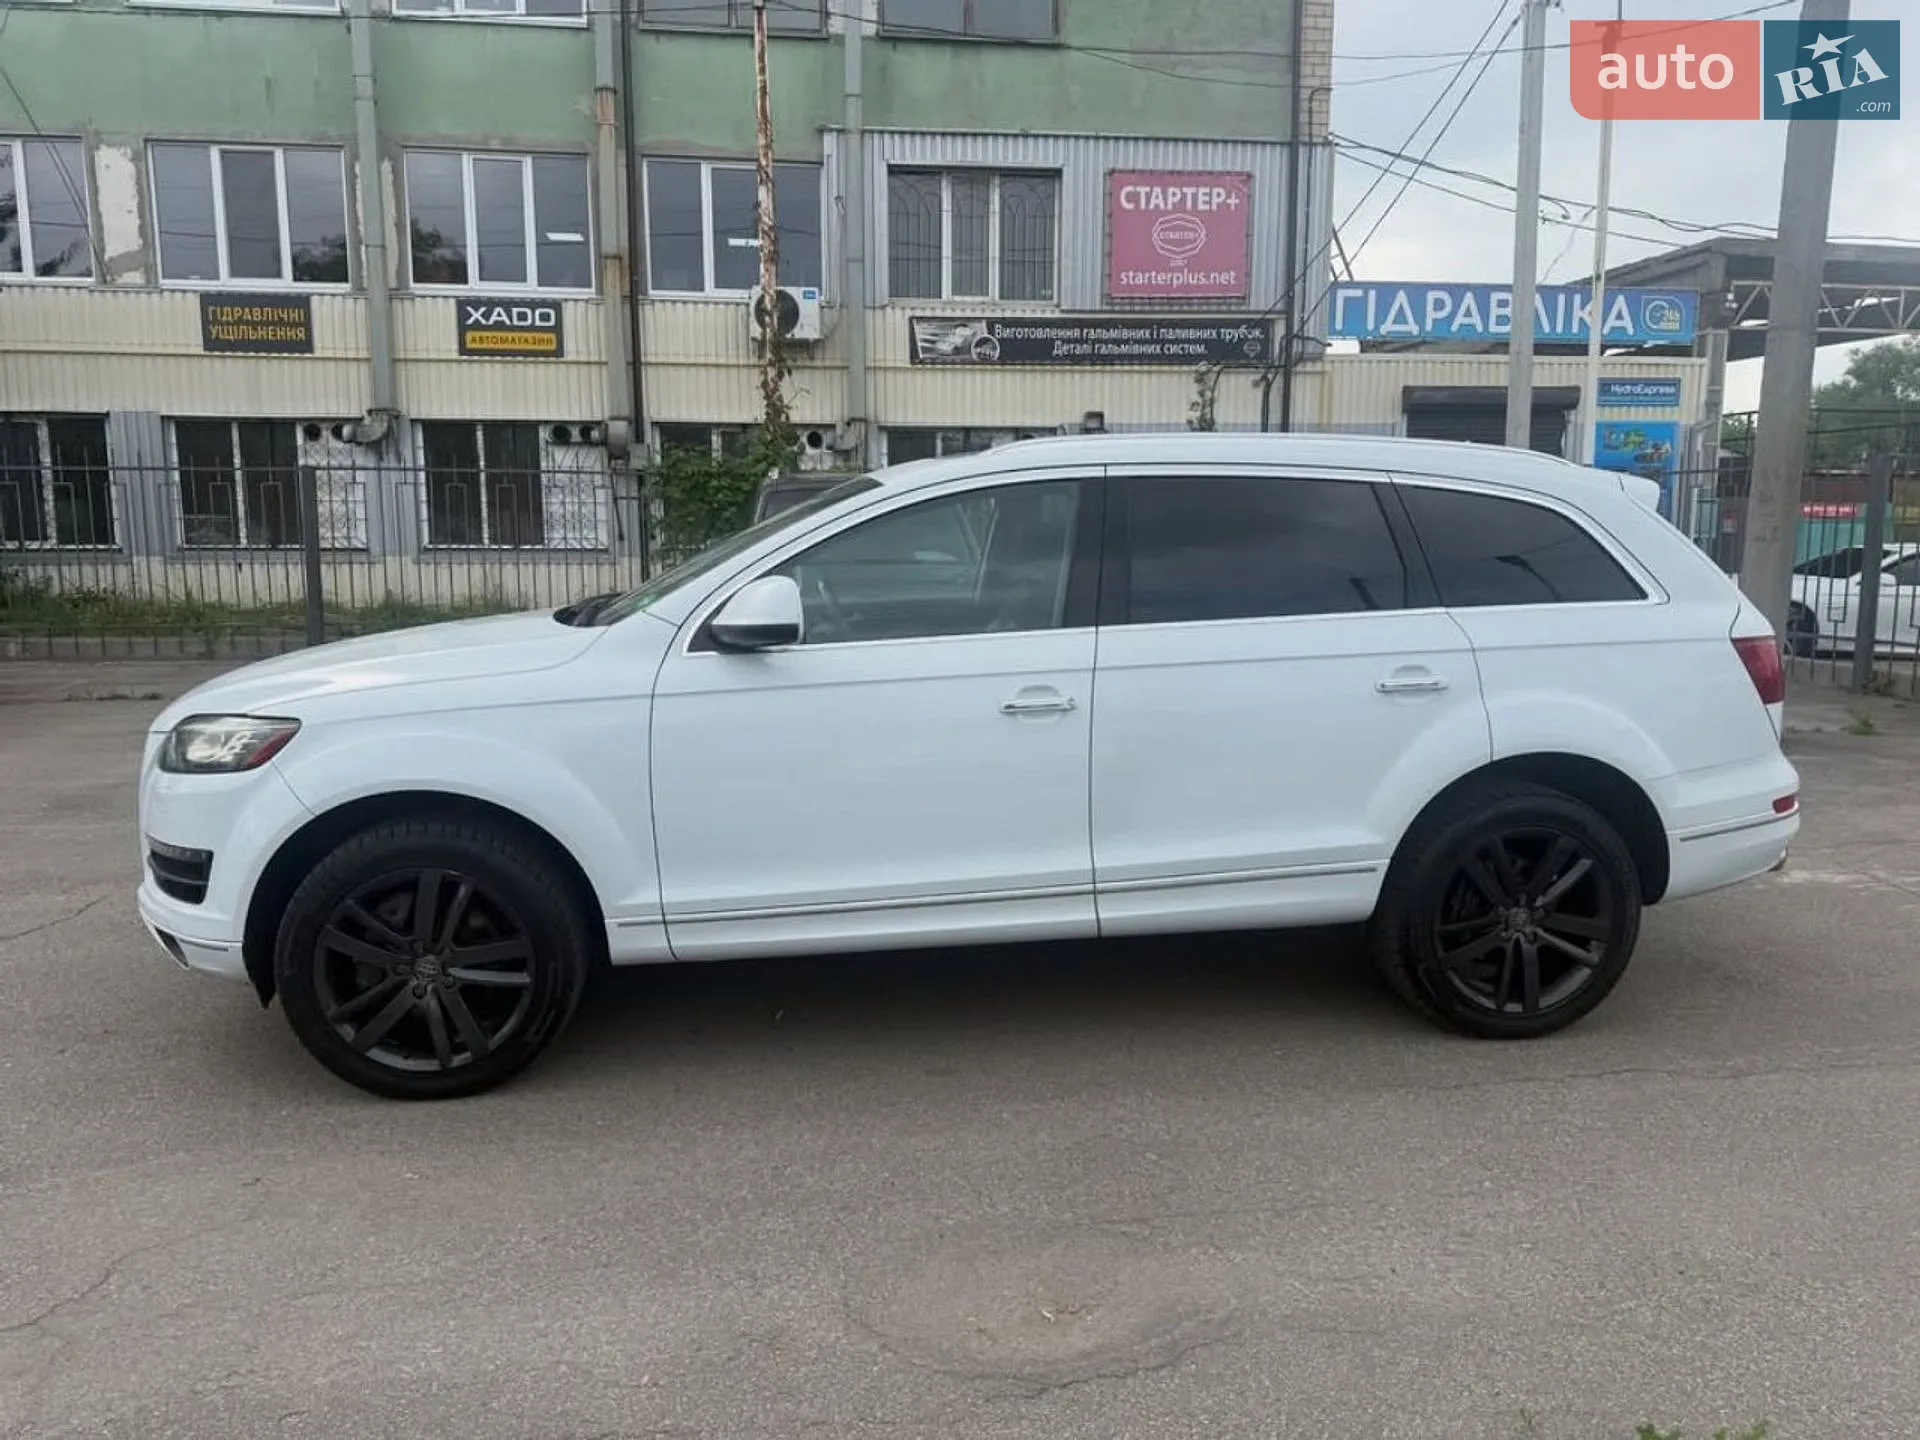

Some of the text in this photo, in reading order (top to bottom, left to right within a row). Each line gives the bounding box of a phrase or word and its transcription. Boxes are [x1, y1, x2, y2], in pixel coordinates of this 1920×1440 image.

[1120, 185, 1240, 211] СТАРТЕР+
[1120, 267, 1236, 288] starterplus.net
[208, 306, 305, 322] ГІДРАВЛІЧНІ
[465, 306, 556, 327] XADO
[209, 324, 306, 343] УЩІЛЬНЕННЯ
[994, 324, 1080, 339] Виготовлення
[1083, 325, 1151, 339] гальмівних
[1159, 327, 1217, 339] паливних
